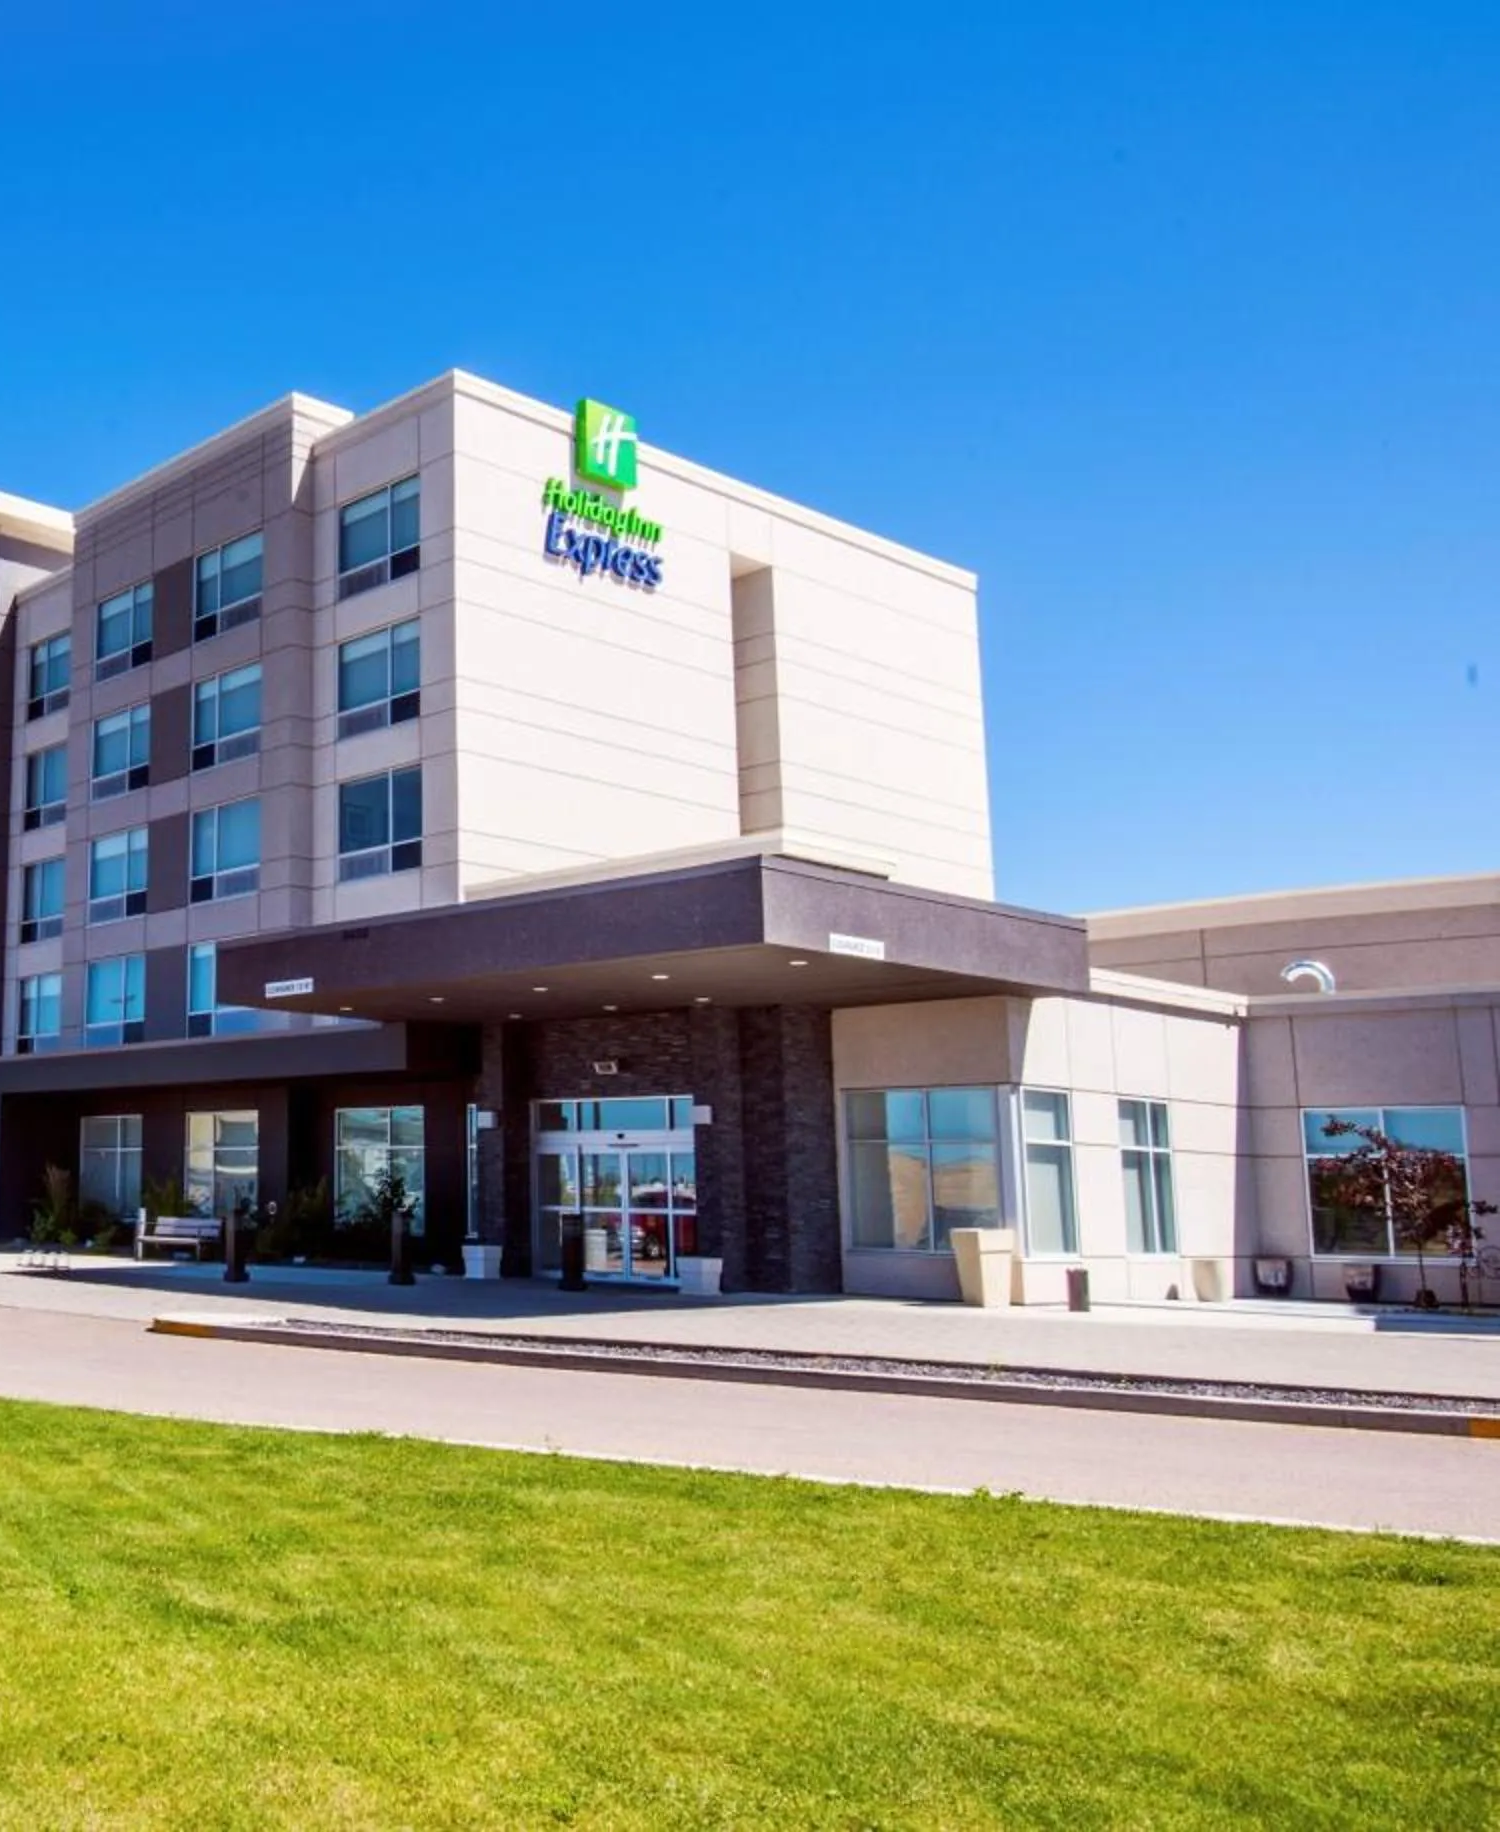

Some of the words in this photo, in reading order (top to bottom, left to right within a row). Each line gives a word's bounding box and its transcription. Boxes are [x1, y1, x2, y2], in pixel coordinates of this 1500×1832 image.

[543, 477, 628, 536] Holiday
[628, 506, 662, 543] Inn
[544, 510, 663, 587] Express
